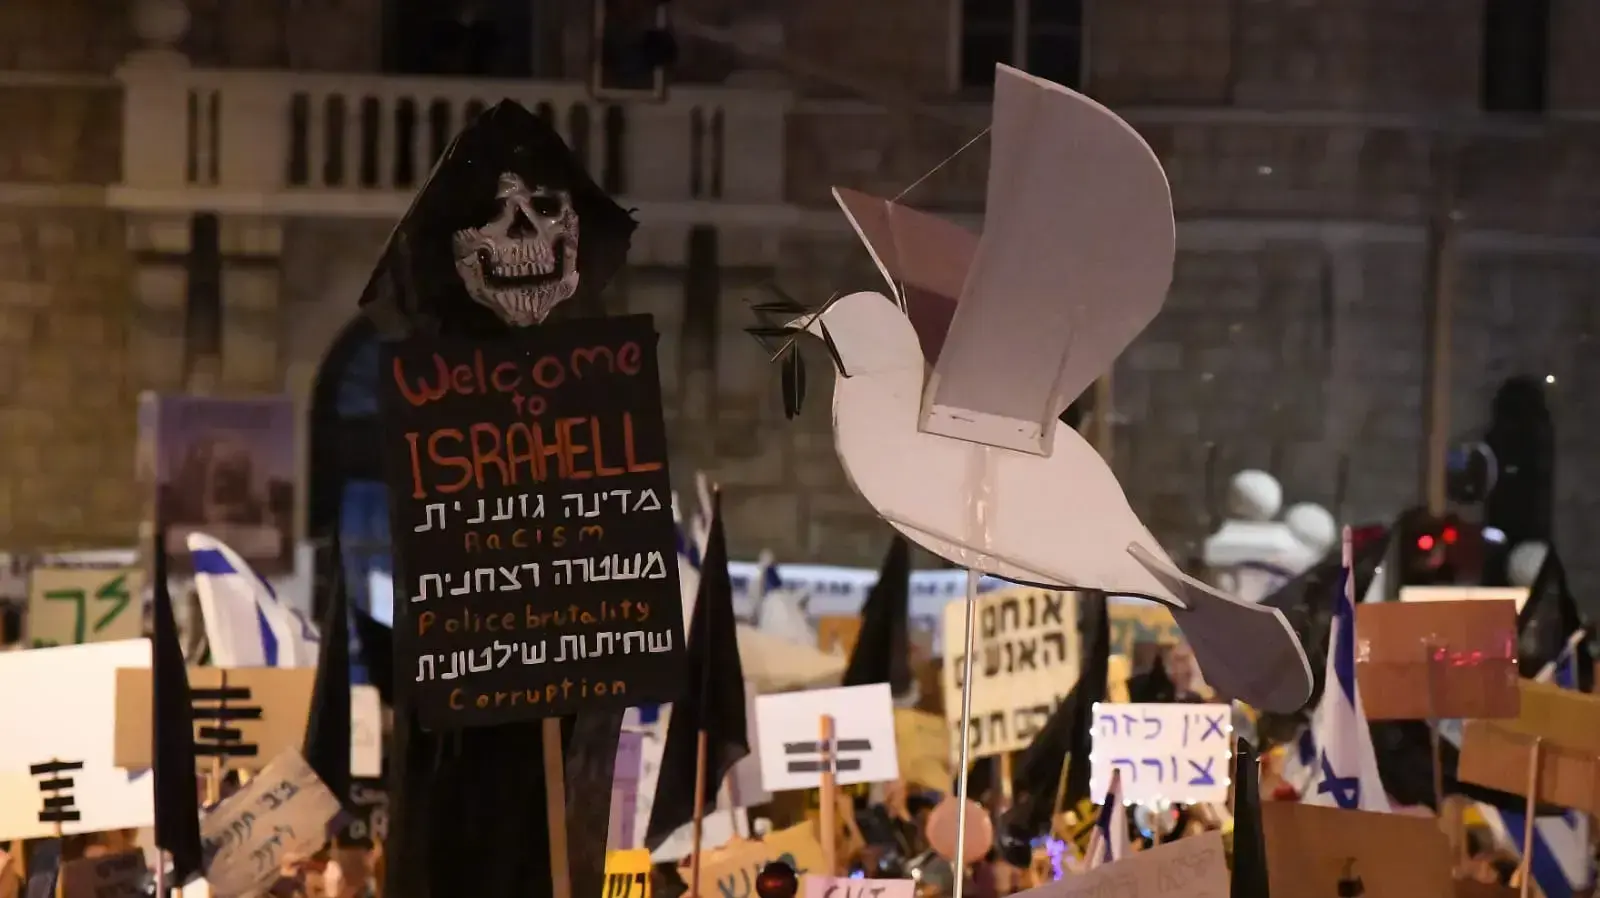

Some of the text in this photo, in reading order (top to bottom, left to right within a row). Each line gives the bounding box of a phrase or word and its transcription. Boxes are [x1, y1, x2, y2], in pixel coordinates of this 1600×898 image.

[393, 341, 642, 406] Welcome
[511, 390, 547, 416] to
[405, 411, 662, 499] ISRAHELL
[414, 488, 661, 533] מדינה גזענית
[411, 550, 667, 602] משטרה רצחנית
[419, 600, 650, 636] Police brutality
[415, 629, 672, 682] שחיתות שילטונית
[450, 677, 626, 710] Corruption
[1182, 714, 1225, 747] אין
[1110, 756, 1215, 785] צורה
